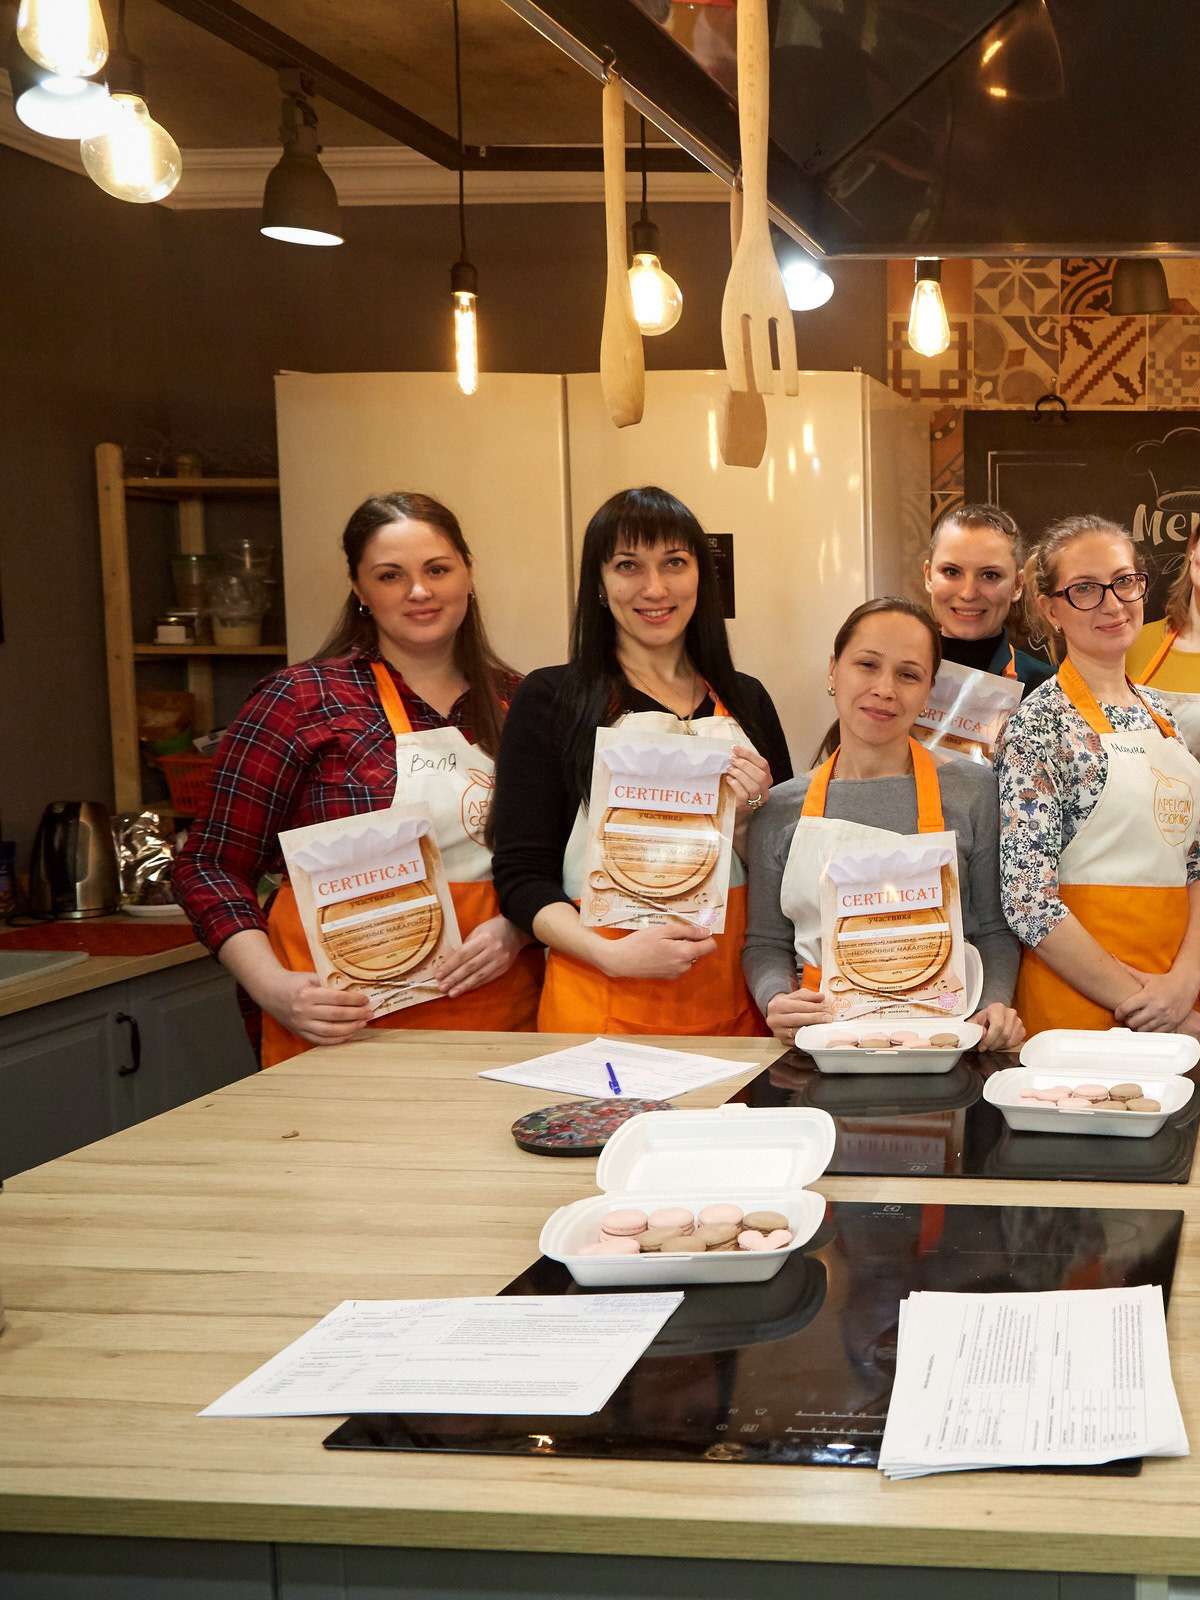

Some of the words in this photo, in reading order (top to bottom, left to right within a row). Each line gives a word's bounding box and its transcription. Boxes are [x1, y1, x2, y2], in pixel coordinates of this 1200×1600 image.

[411, 753, 457, 773] Валя
[614, 785, 716, 806] CERTIFICAT
[1158, 798, 1191, 813] APELCIN
[1158, 813, 1189, 825] COOKING
[318, 859, 420, 896] CERTIFICAT
[868, 913, 912, 924] участника
